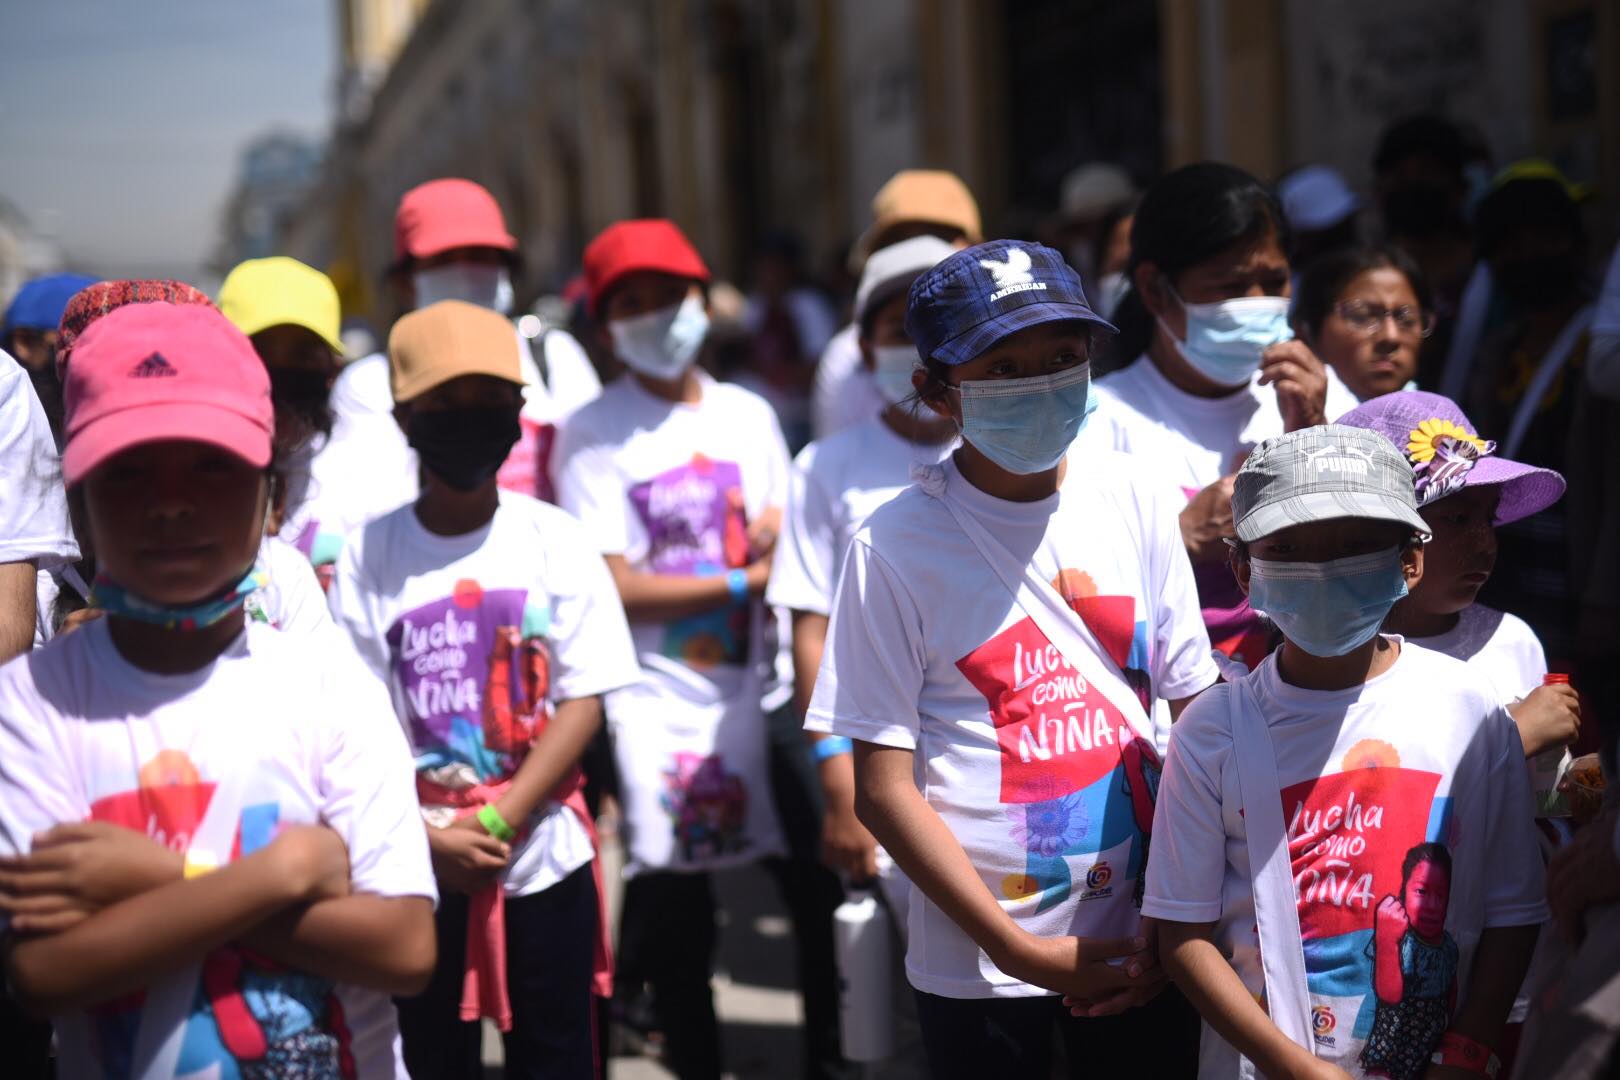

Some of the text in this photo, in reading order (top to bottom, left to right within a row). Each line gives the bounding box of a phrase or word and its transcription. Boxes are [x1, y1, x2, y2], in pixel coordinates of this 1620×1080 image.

[990, 282, 1047, 302] AMERICAN
[1315, 457, 1368, 476] PUMA
[1018, 701, 1115, 763] NIÑA
